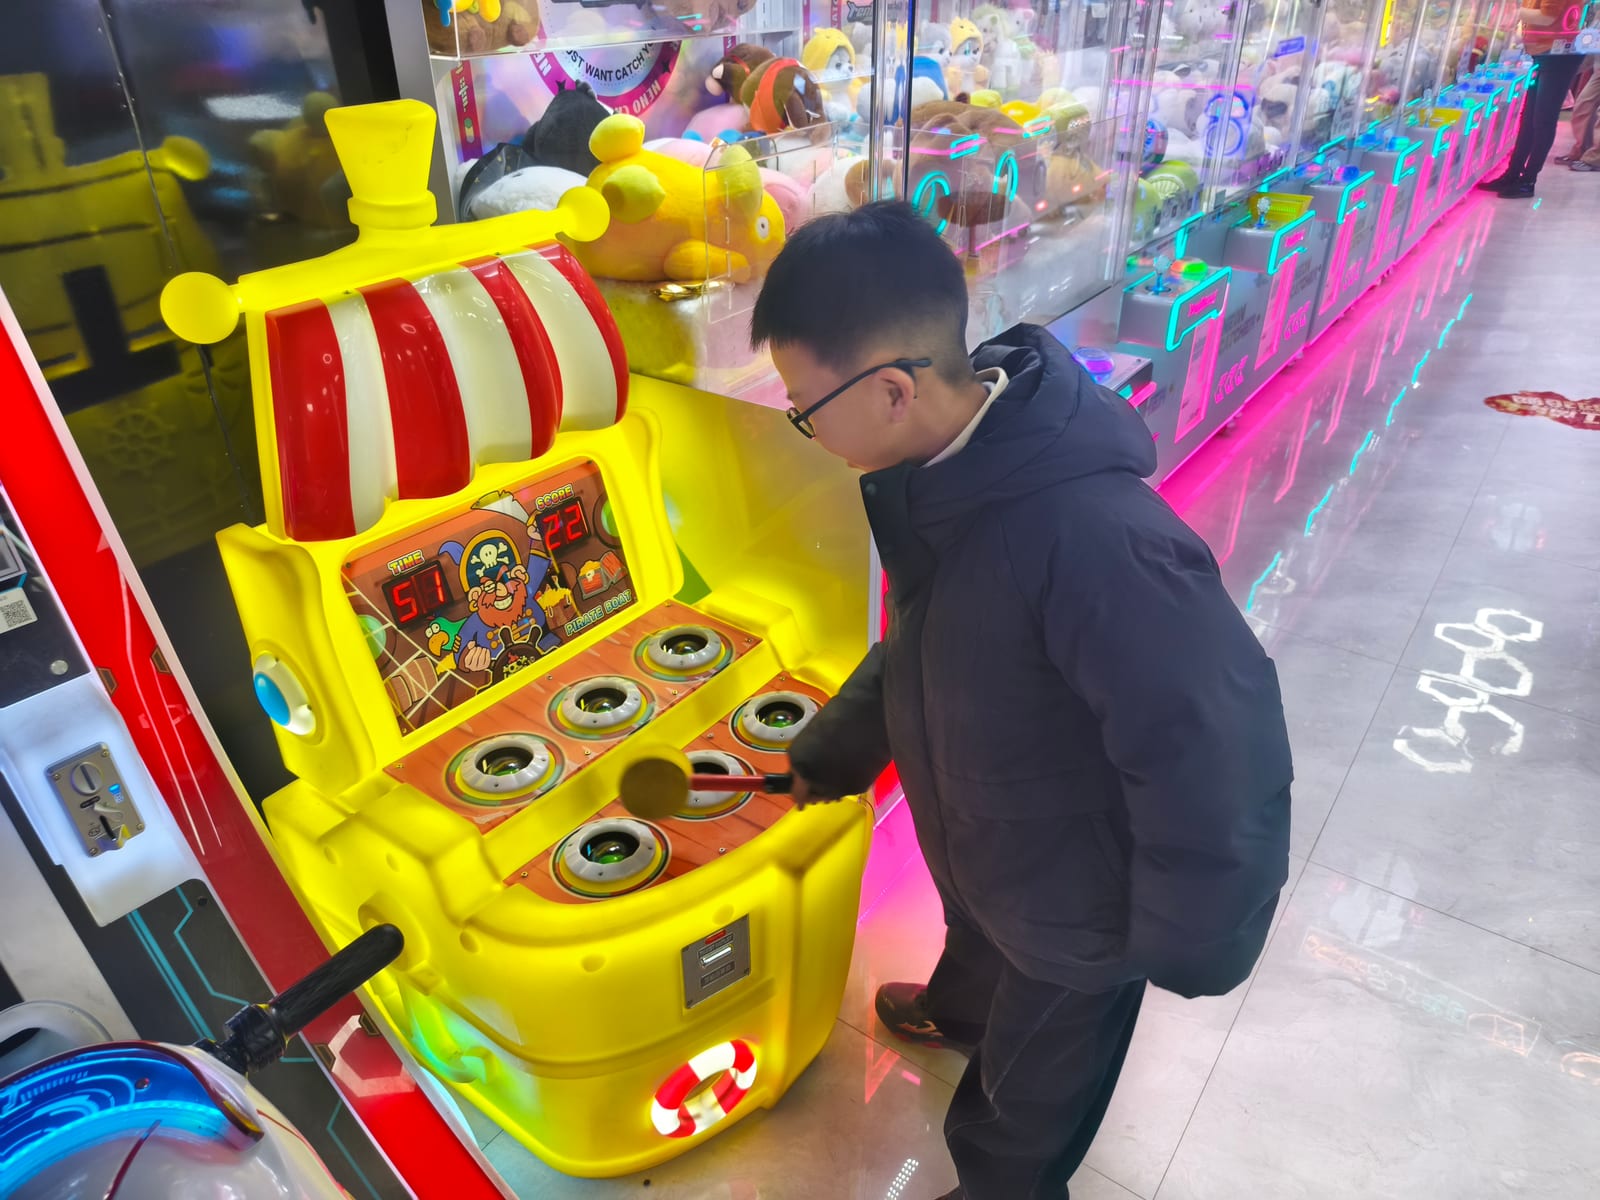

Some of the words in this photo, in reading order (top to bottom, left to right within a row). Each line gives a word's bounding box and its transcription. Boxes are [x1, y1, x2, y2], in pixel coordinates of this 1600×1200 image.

[585, 62, 614, 81] WANT
[615, 55, 645, 80] CATCH
[536, 485, 573, 510] SCORE
[542, 504, 582, 550] 22
[389, 550, 424, 575] TIME
[392, 571, 444, 622] 51
[564, 606, 604, 636] PIRATE
[604, 589, 632, 613] BOAT
